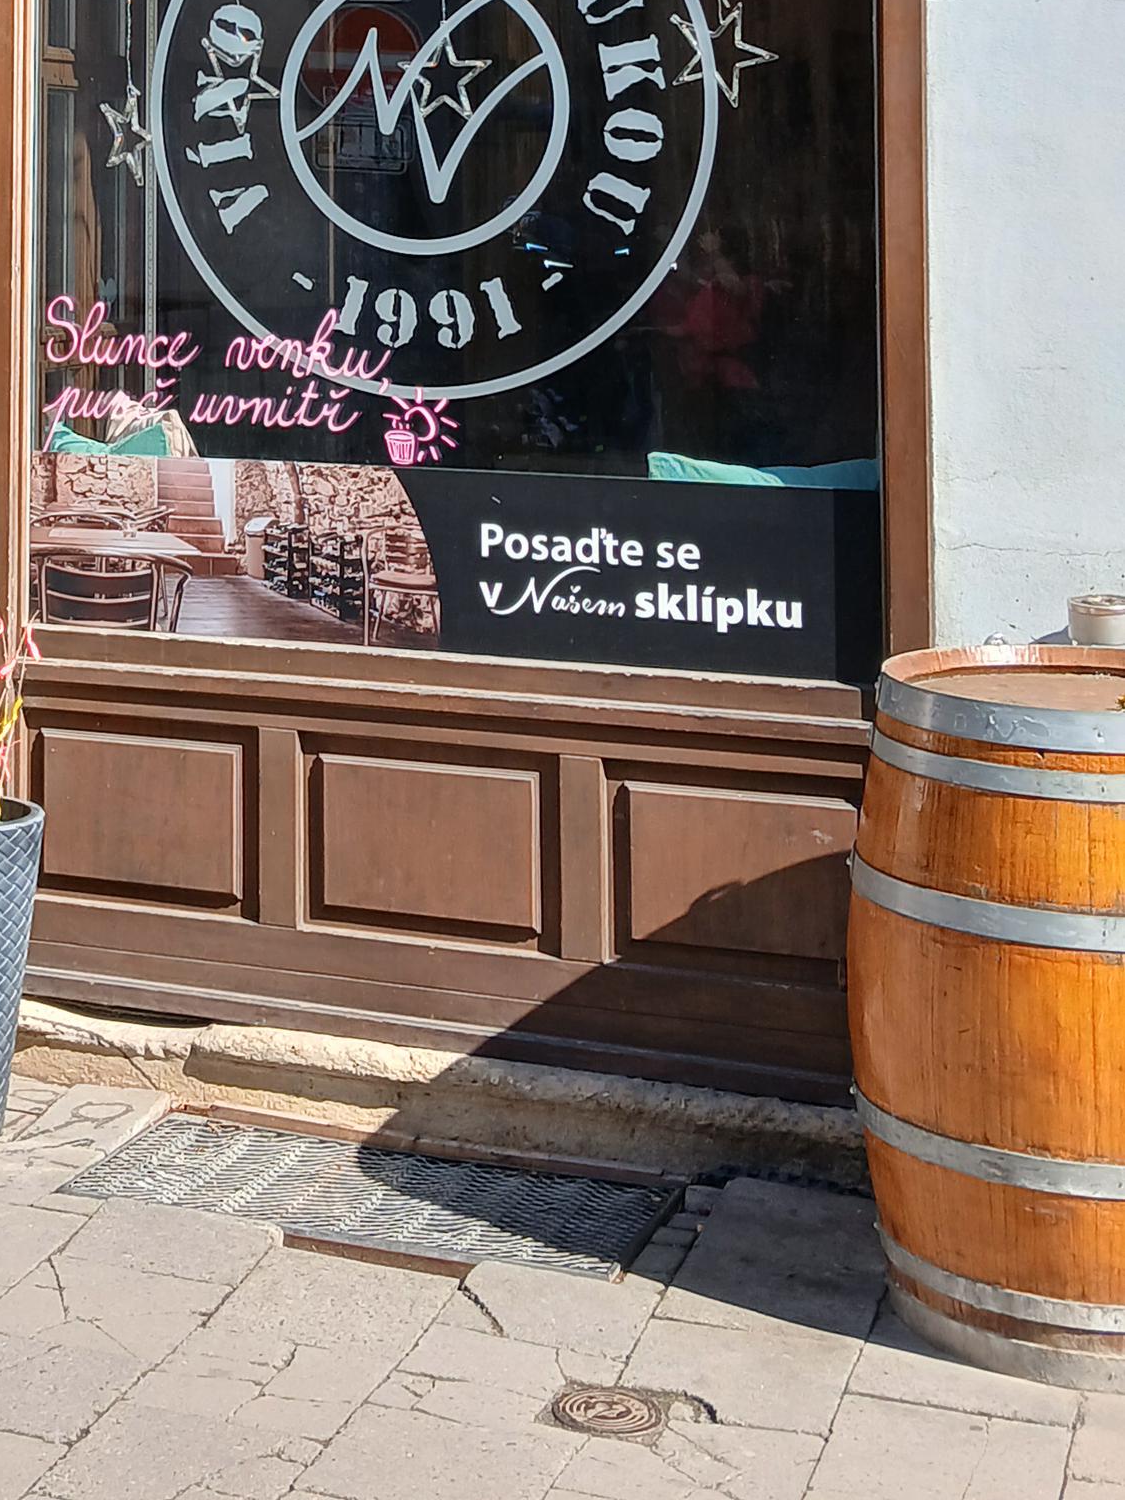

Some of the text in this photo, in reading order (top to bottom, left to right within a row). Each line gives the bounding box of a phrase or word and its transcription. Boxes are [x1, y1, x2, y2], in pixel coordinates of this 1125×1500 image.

[186, 4, 269, 234] VÍNO
[45, 295, 201, 368] Slunce
[333, 275, 522, 349] 1991
[189, 386, 363, 432] uvnitř
[480, 522, 702, 571] Posaďte se
[479, 565, 803, 633] v Našem sklípku
